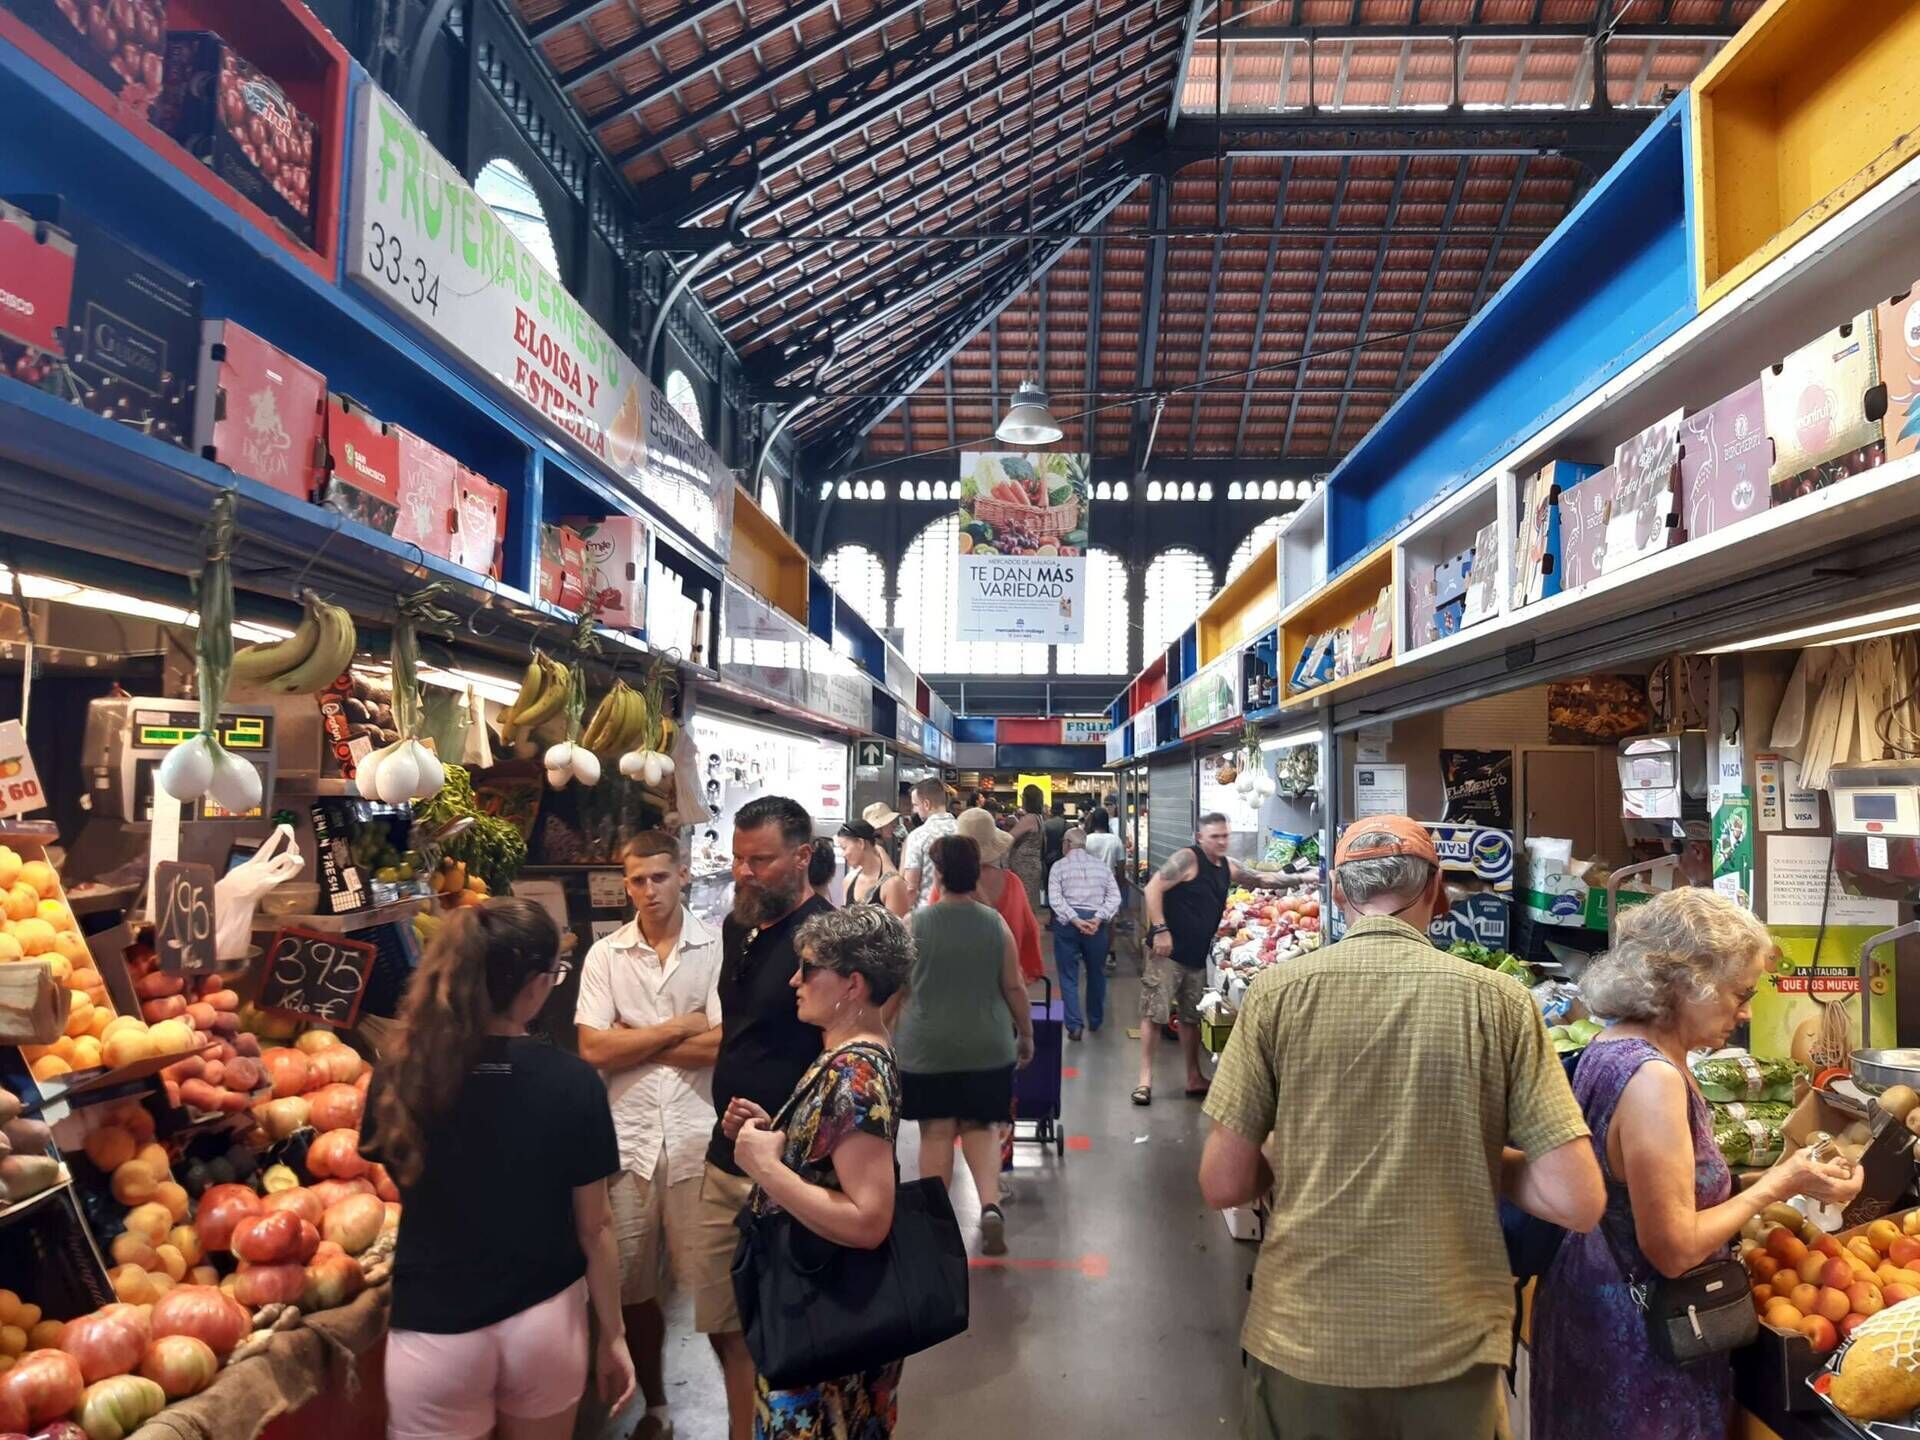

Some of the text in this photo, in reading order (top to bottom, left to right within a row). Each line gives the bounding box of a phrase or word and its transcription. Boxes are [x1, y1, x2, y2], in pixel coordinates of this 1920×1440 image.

[378, 102, 620, 388] FRUTERIAS ERNESTO
[369, 222, 440, 317] 33-34
[513, 306, 600, 409] ELOISA Y
[515, 356, 606, 459] ESTRELLA
[650, 389, 706, 461] SERVICIO
[354, 460, 387, 485] FRANCISCO
[970, 563, 1074, 583] TE DAN MÁS
[980, 582, 1063, 598] VARIEDAD
[1721, 763, 1741, 777] VISA
[311, 807, 331, 848] LEMON
[1794, 813, 1813, 821] VISA
[1797, 967, 1807, 976] LA
[1782, 979, 1803, 991] QUE
[1827, 980, 1860, 991] MUEVE
